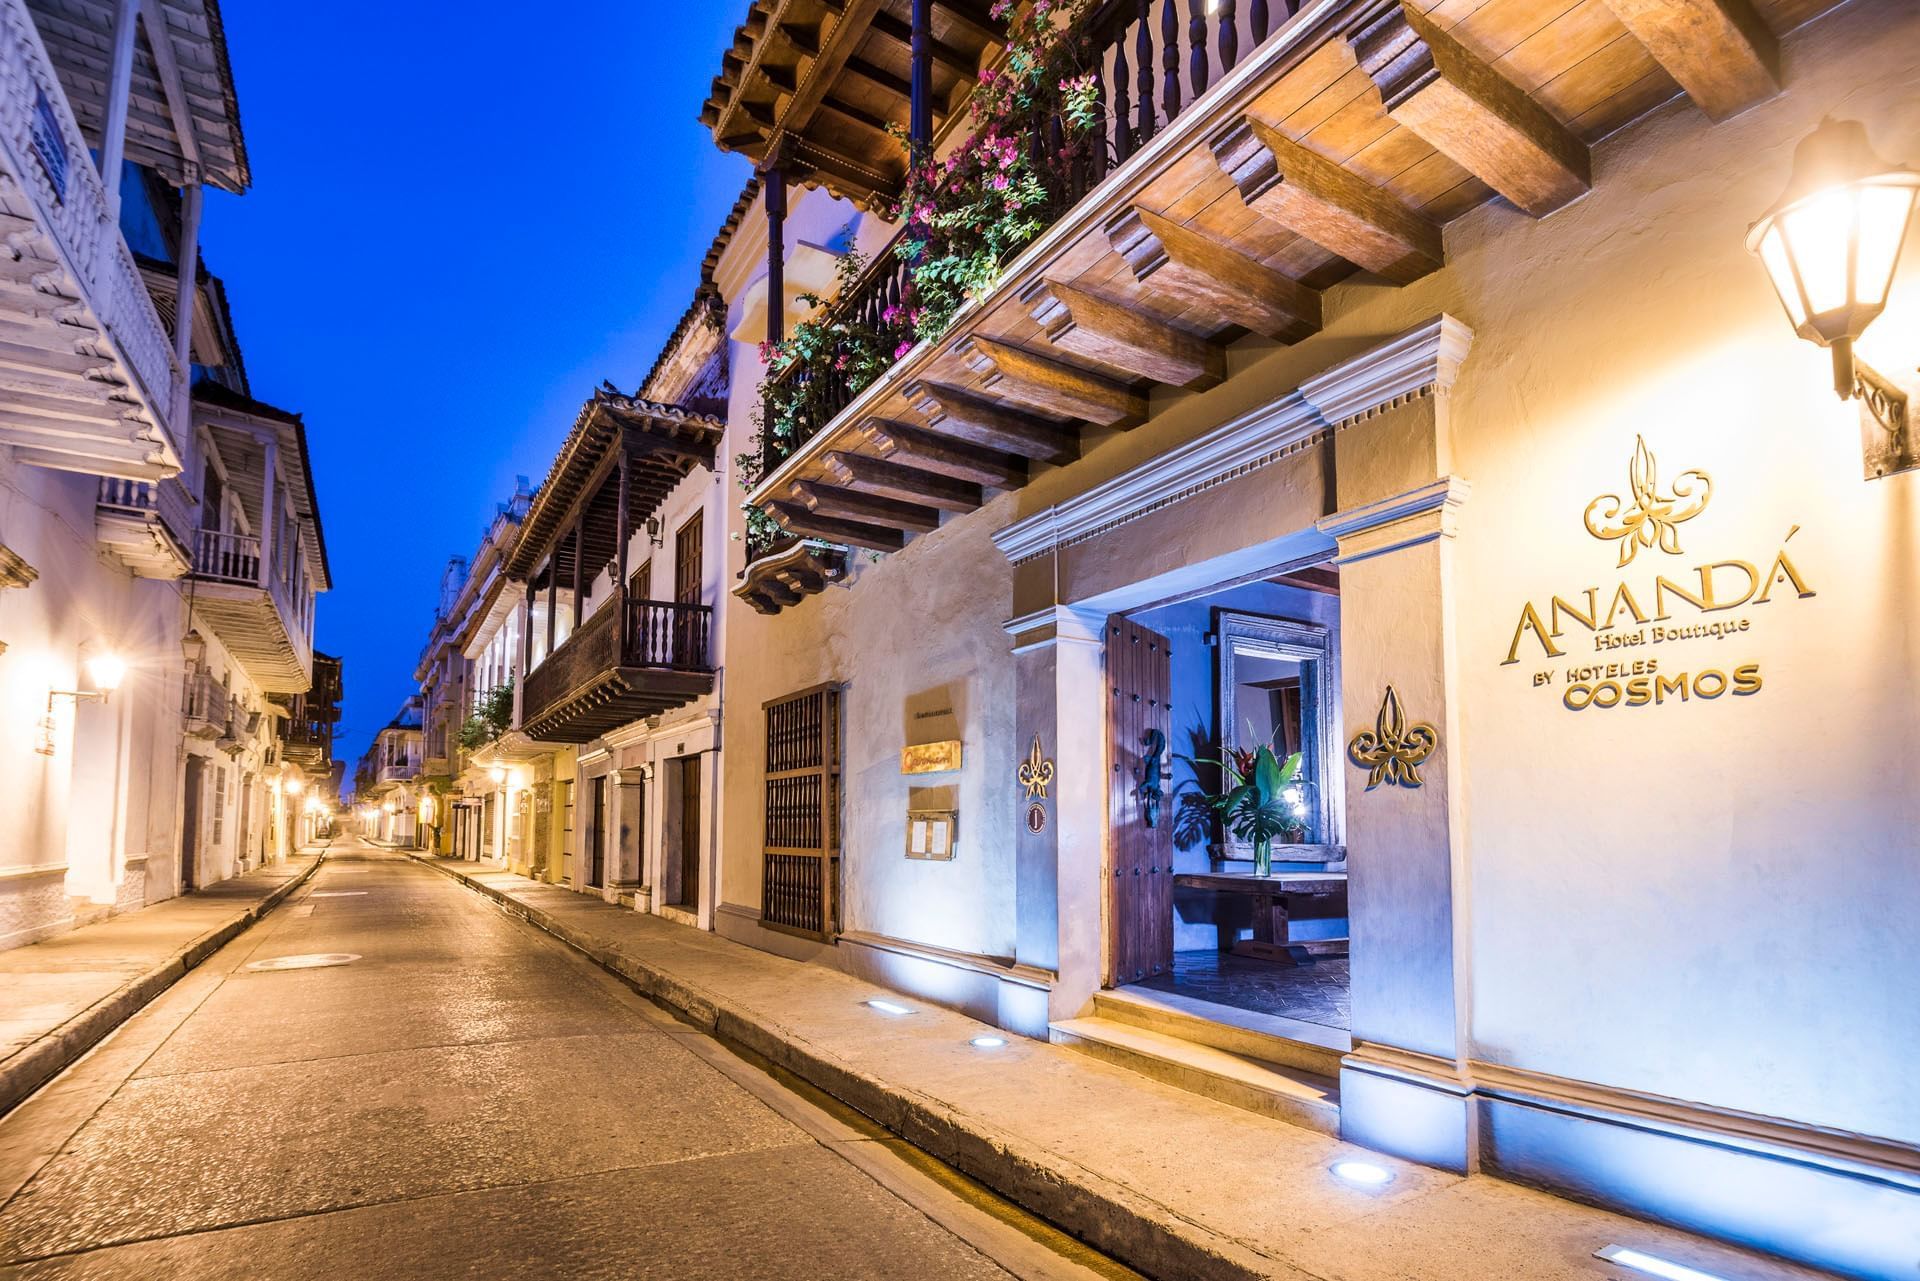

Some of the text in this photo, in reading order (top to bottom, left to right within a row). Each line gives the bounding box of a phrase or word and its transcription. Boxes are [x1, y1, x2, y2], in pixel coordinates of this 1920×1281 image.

[1500, 525, 1816, 665] ANANDÁ
[1594, 618, 1750, 651] Hotel Boutique
[1533, 659, 1658, 687] BY HOTELES
[1563, 664, 1763, 711] COSMOS
